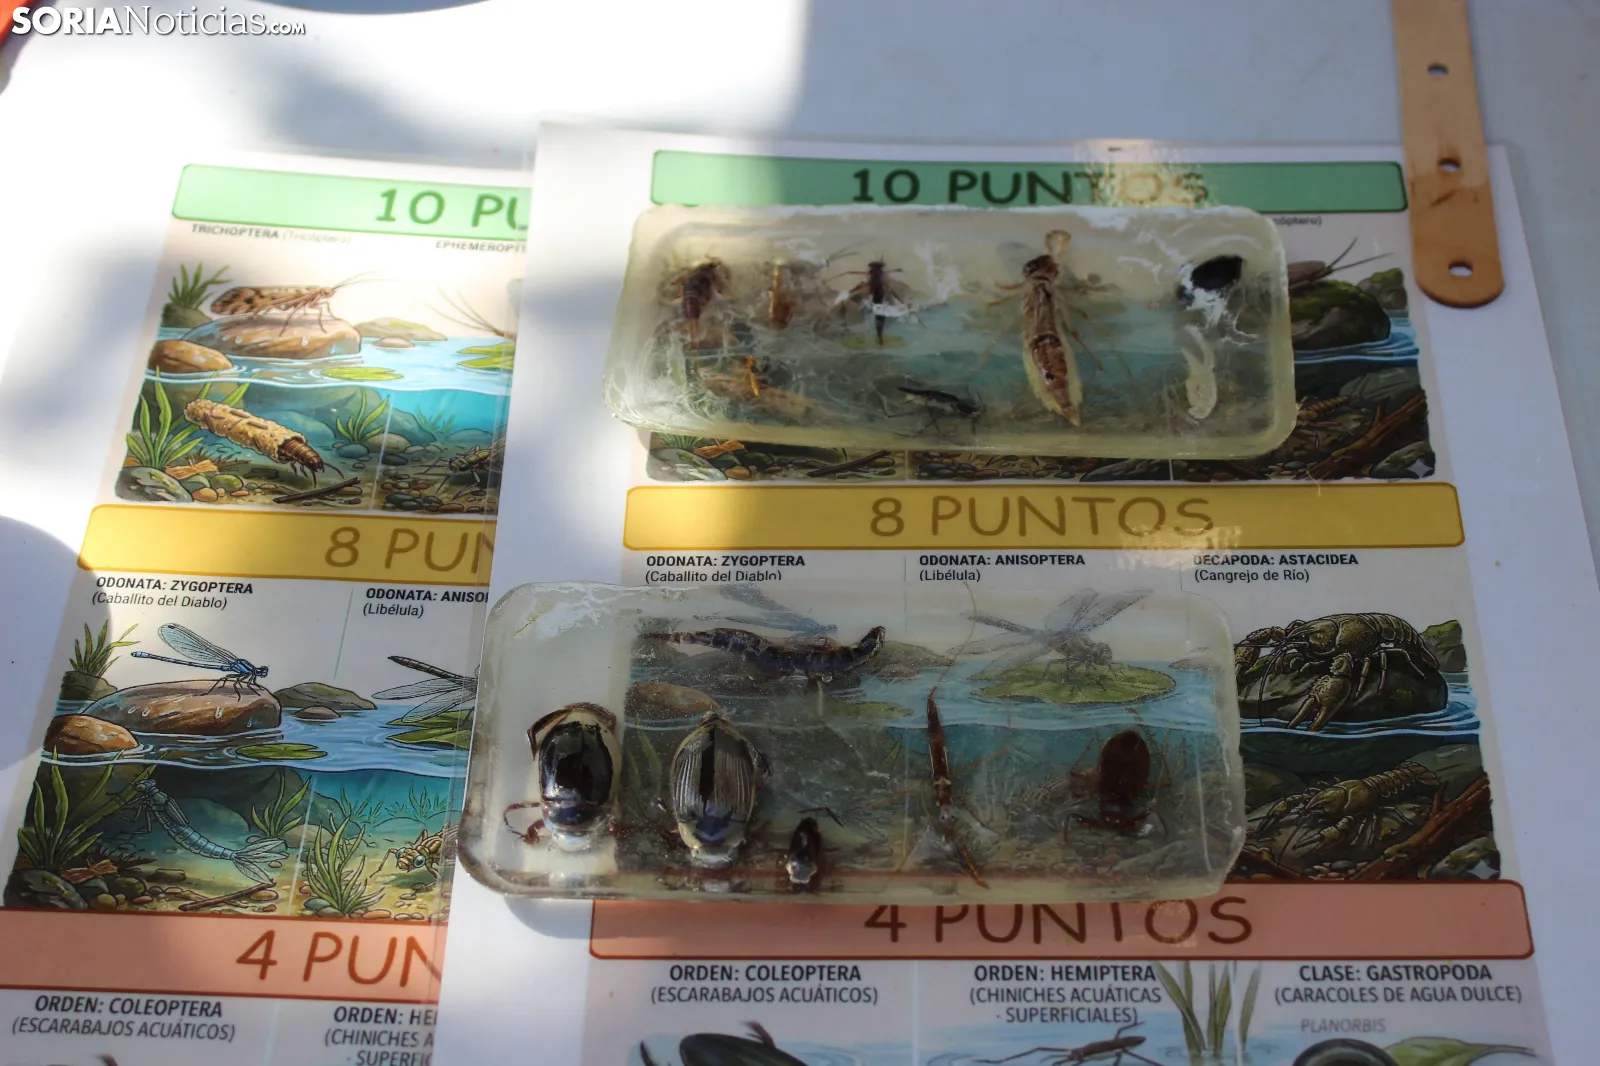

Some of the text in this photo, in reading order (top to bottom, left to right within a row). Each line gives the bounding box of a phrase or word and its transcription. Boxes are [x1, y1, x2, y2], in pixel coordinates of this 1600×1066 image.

[852, 168, 1209, 206] 10 PUNTOS
[376, 188, 446, 225] 10
[191, 223, 279, 239] TRICHOPTERA
[870, 496, 1214, 537] 8 PUNTOS
[325, 526, 360, 567] 8
[646, 555, 806, 567] ODONATA: ZYGOPTERA
[919, 555, 1086, 567] ODONATA: ANISOPTERA
[1279, 554, 1359, 565] ASTACIDEA
[96, 576, 253, 594] ODONATA: ZYGOPTERA
[645, 569, 782, 584] (Caballito del Diablo)
[919, 569, 981, 583] (Libélula)
[1194, 569, 1310, 583] (Cangrejo de Río)
[92, 591, 228, 611] (Caballito del Diablo)
[366, 587, 437, 602] ODONATA:
[363, 602, 424, 619] (Libélula)
[236, 929, 277, 980] 4
[669, 964, 861, 982] ORDEN: COLEOPTERA
[974, 965, 1156, 982] ORDEN: HEMIPTERA
[1299, 964, 1492, 981] CLASE: GASTROPODA
[651, 984, 878, 1006] (ESCARABAJOS ACUÁTICOS)
[969, 984, 1162, 1006] (CHINICHES ACUÁTICAS
[1274, 985, 1522, 1006] (CARACOLES DE AGUA DULCE)
[35, 995, 223, 1017] ORDEN: COLEOPTERA
[333, 1006, 437, 1026] ORDEN: HE
[1005, 1007, 1138, 1025] SUPERFICIALES)
[12, 1016, 235, 1043] (ESCARABAJOS ACUÁTICOS)
[1301, 1019, 1387, 1033] PLANORBIS
[324, 1028, 419, 1047] (CHINICHES
